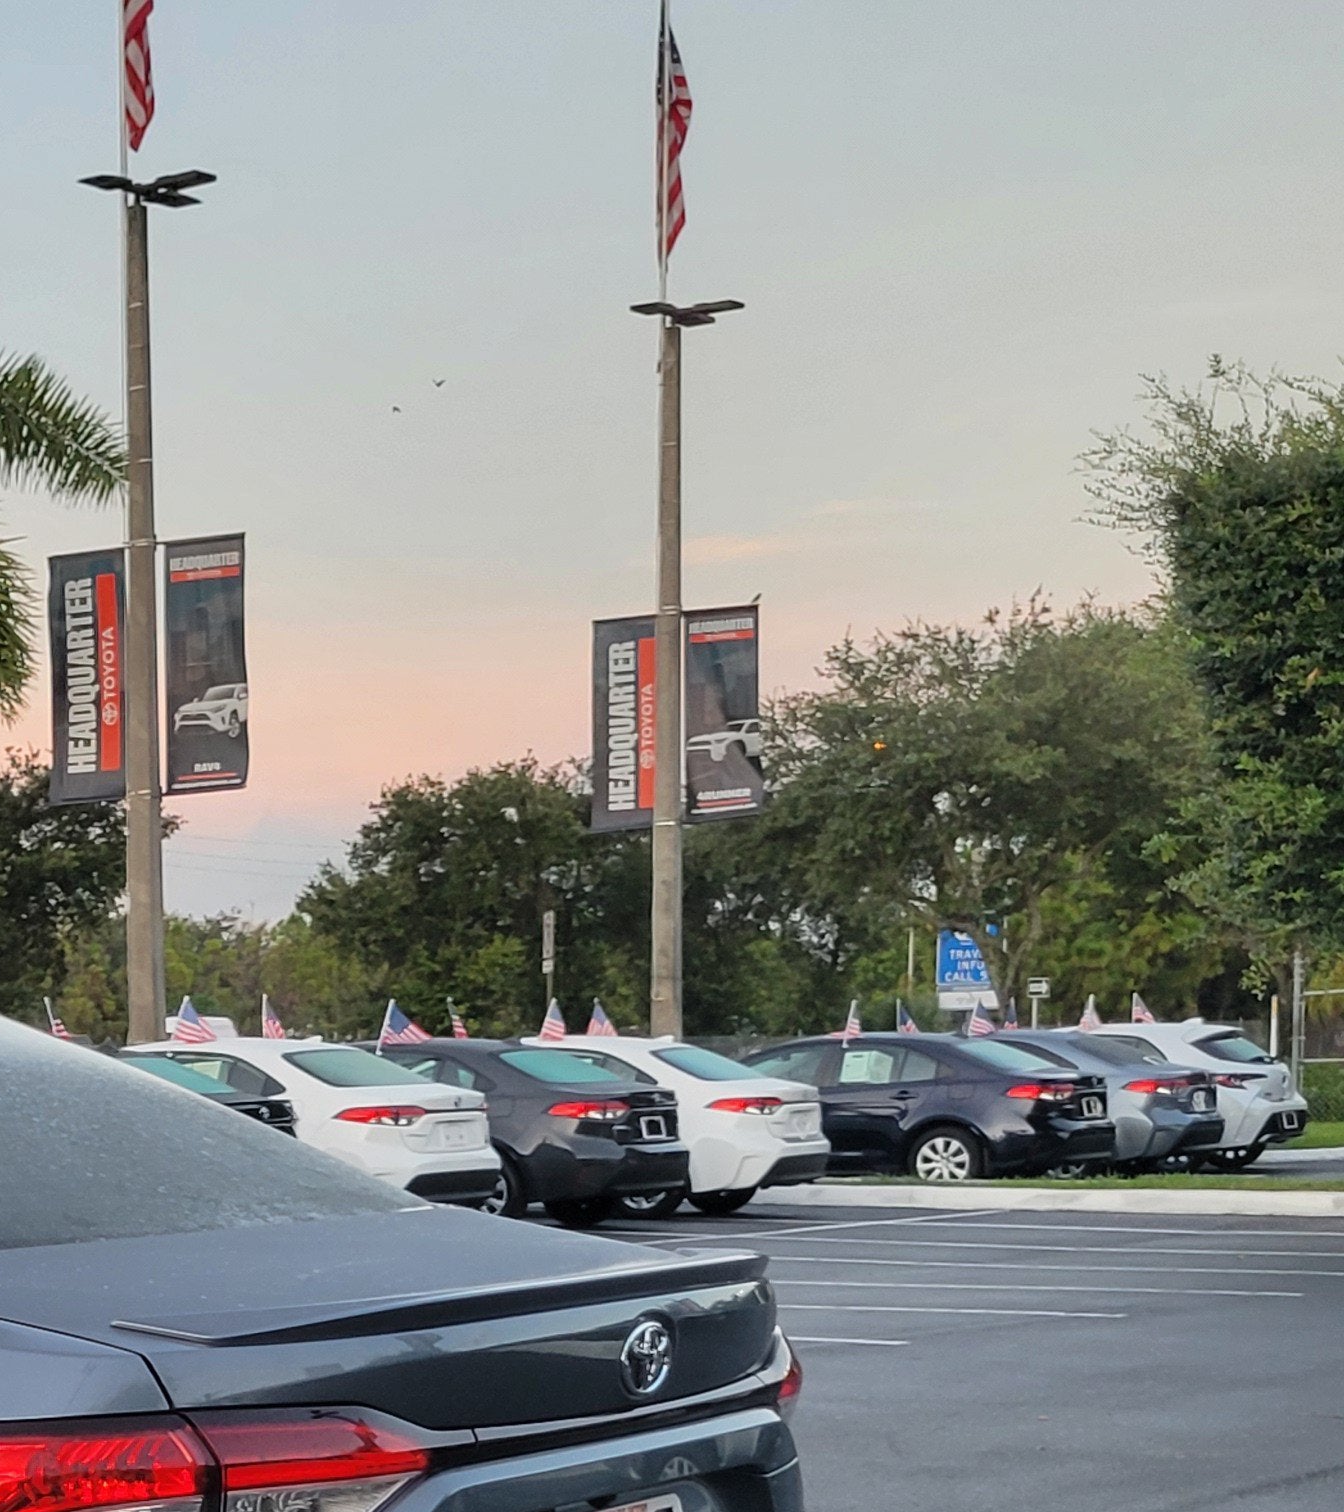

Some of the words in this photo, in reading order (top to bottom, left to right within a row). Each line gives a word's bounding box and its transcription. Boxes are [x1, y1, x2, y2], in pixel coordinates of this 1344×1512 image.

[64, 577, 100, 774] HEADQUARTER
[101, 626, 116, 699] TOYOTA
[608, 640, 638, 811] HEADQUARTER
[641, 683, 654, 743] TOYOTA
[945, 971, 972, 982] CALL
